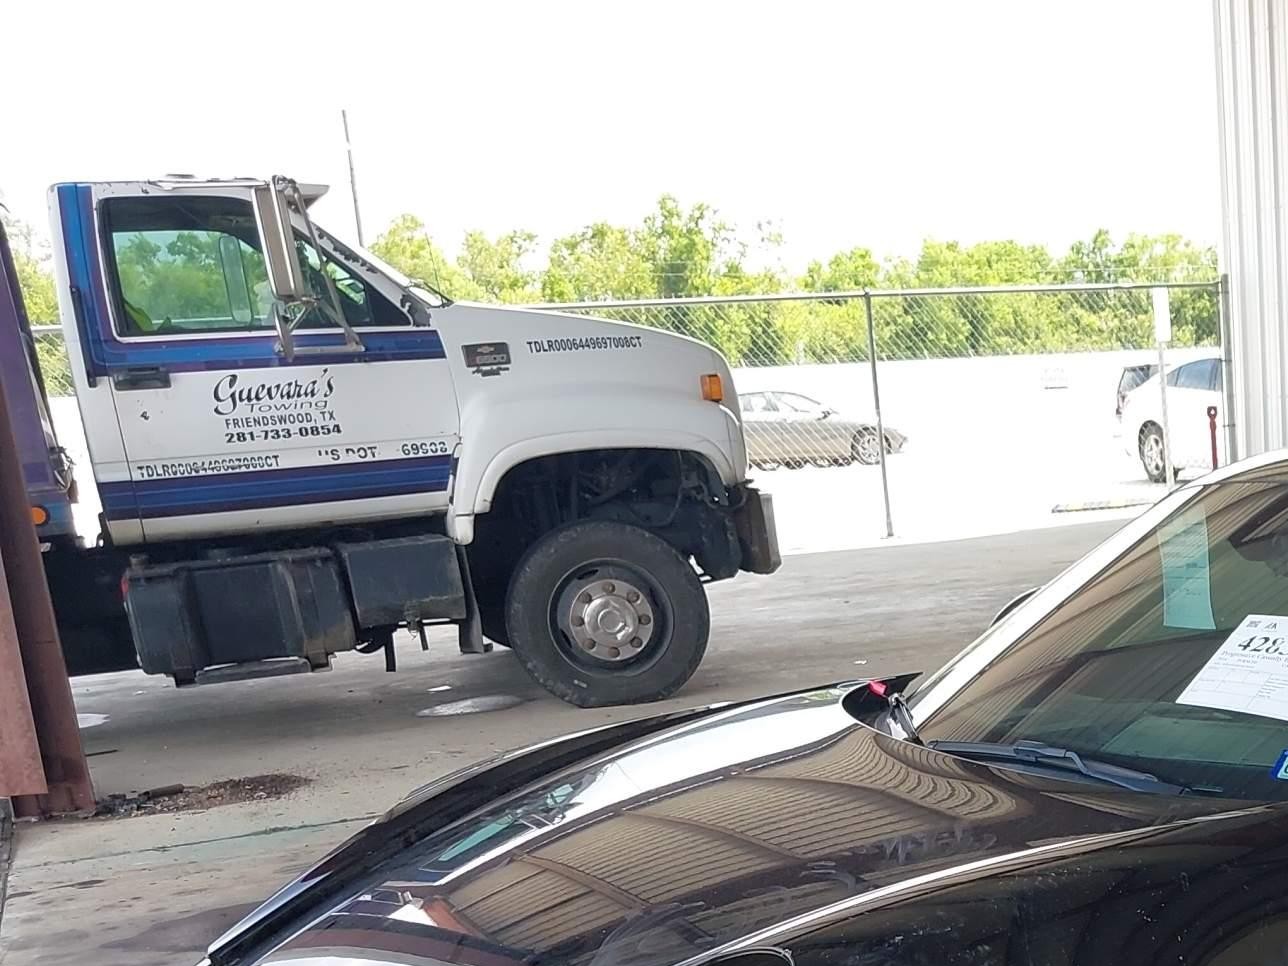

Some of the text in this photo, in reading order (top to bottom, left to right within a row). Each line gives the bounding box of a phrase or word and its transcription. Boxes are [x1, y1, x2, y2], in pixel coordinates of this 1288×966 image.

[213, 368, 335, 415] Guevara's
[244, 400, 329, 413] Towing
[225, 410, 336, 430] FRIENDSWOOD, TX
[225, 424, 342, 444] 281-733-0854
